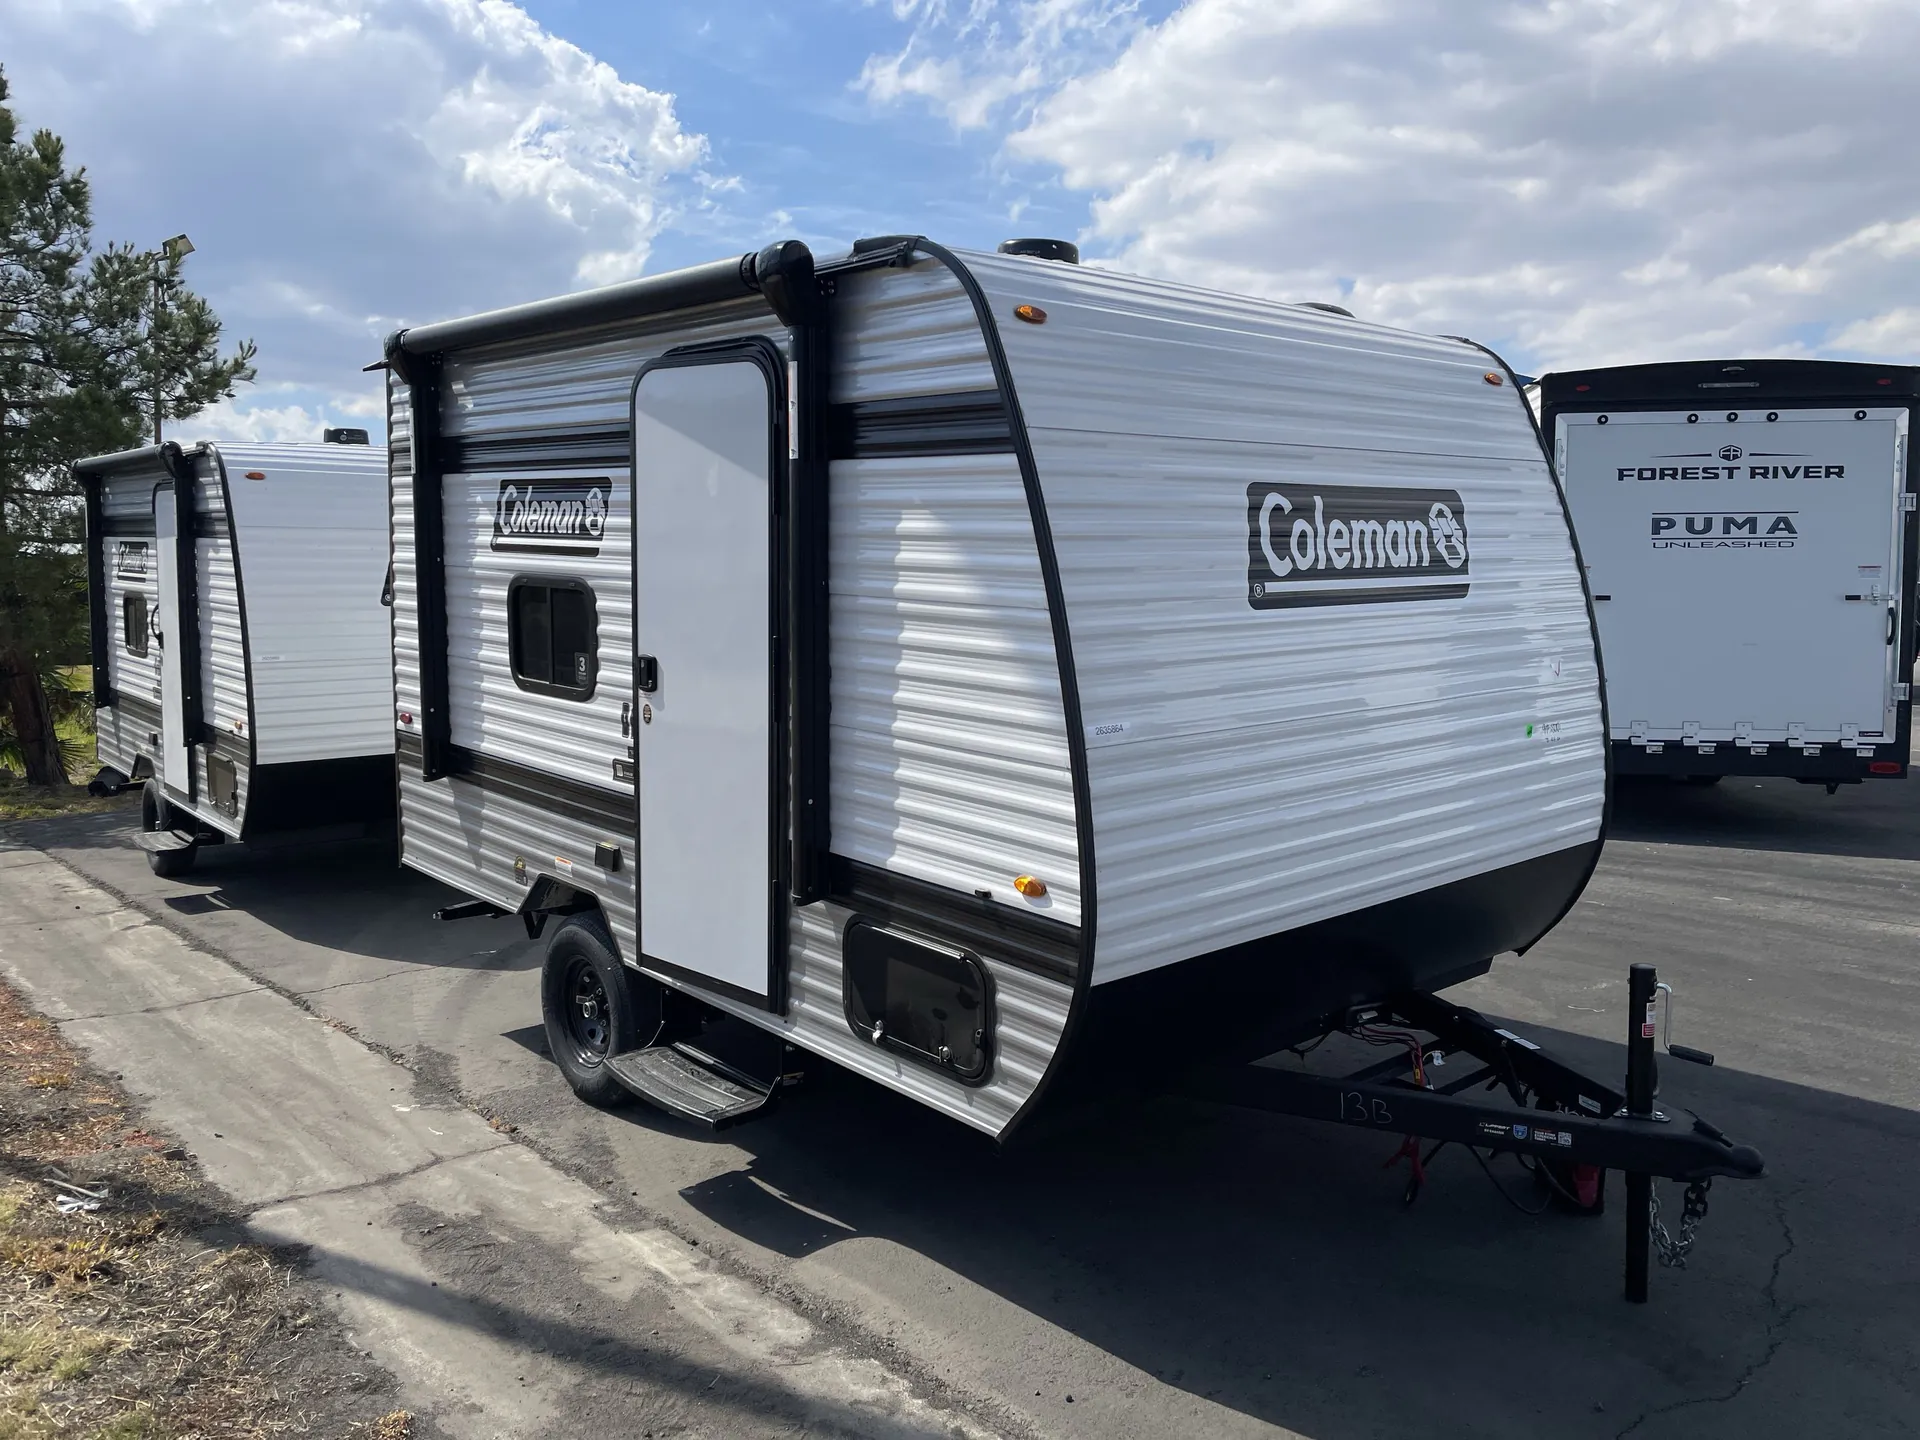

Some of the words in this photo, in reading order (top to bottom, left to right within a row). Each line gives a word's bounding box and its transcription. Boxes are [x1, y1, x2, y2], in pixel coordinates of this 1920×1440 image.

[1616, 466, 1741, 481] FOREST
[1748, 465, 1845, 479] RIVER
[500, 485, 584, 535] Coleman
[1259, 492, 1431, 577] Coleman
[1651, 516, 1798, 535] PUMA
[1652, 541, 1795, 549] UNLEASHED
[579, 657, 586, 672] 3
[1340, 1091, 1393, 1124] 13B
